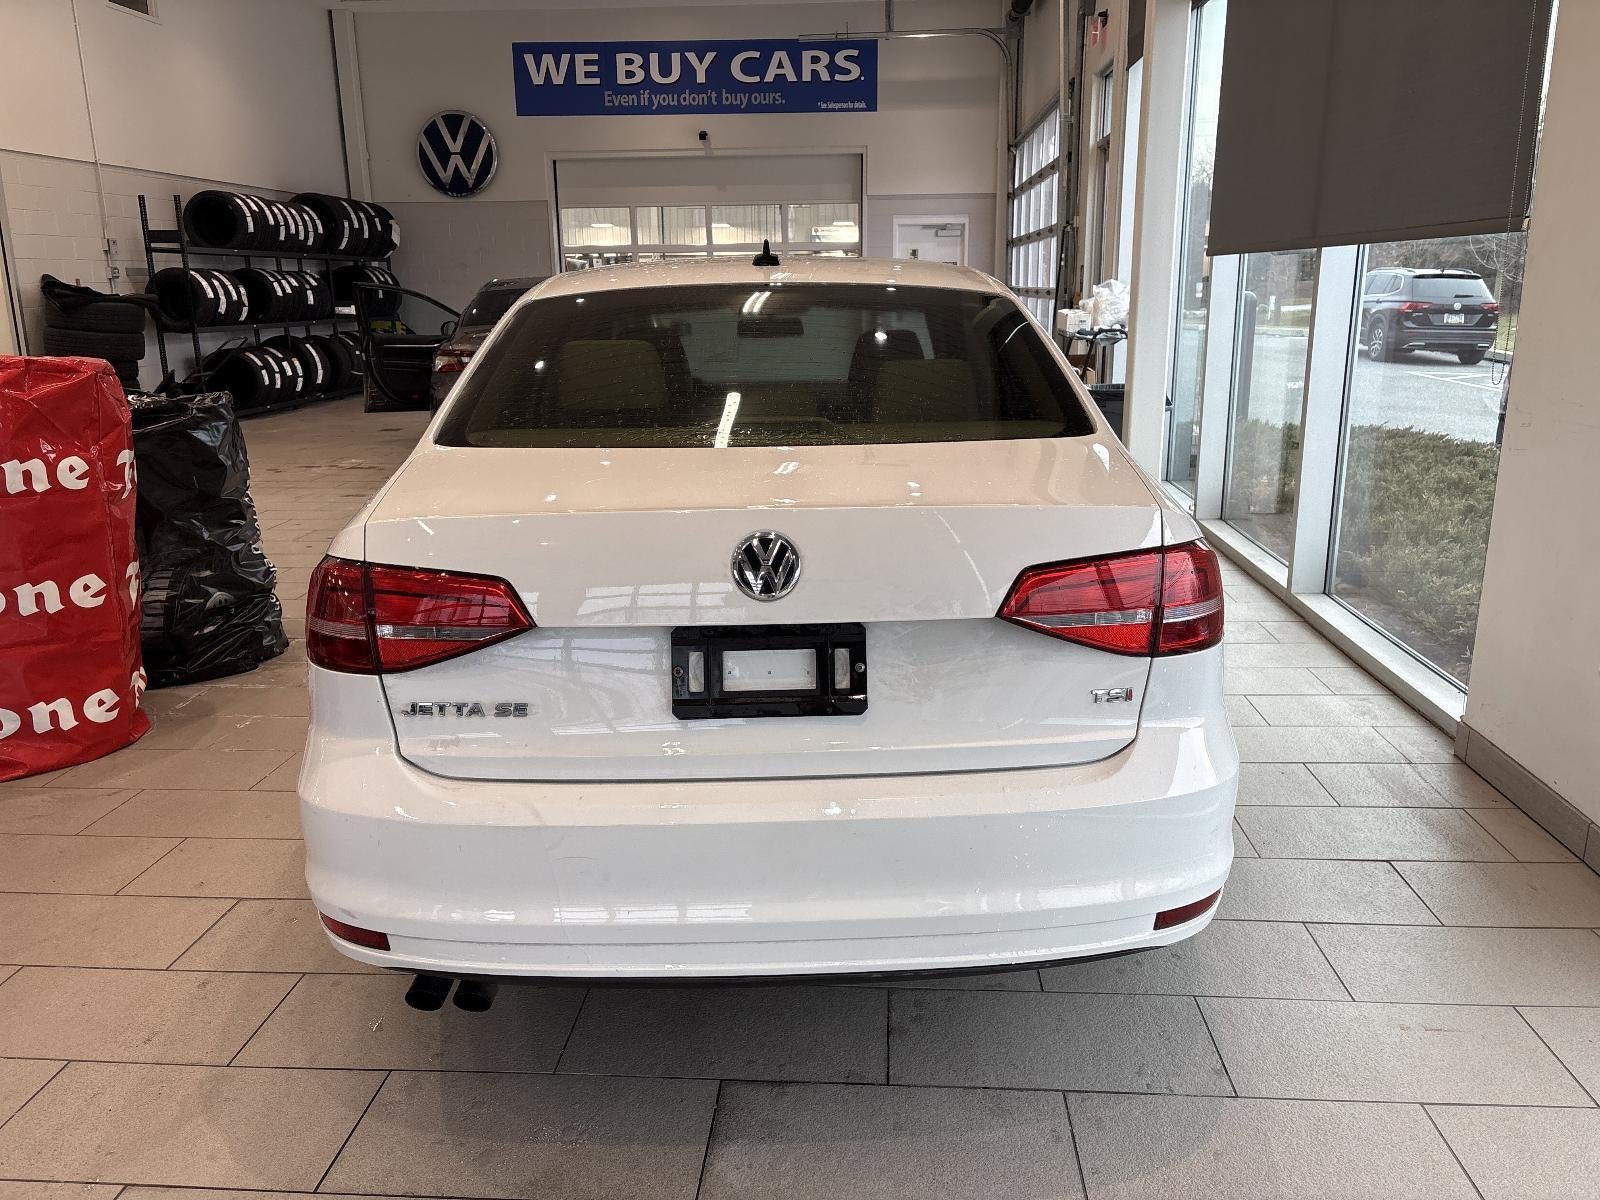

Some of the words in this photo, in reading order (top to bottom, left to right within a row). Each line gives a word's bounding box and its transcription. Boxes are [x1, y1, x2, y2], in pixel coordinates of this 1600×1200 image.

[523, 53, 601, 86] WE
[615, 51, 717, 85] BUY
[730, 49, 866, 84] CARS.
[604, 91, 638, 107] Even
[640, 90, 650, 106] if
[651, 92, 678, 110] you
[680, 89, 717, 105] don't
[722, 88, 749, 109] buy
[751, 91, 786, 104] ours.
[401, 702, 486, 718] JETTA
[494, 702, 529, 718] SE
